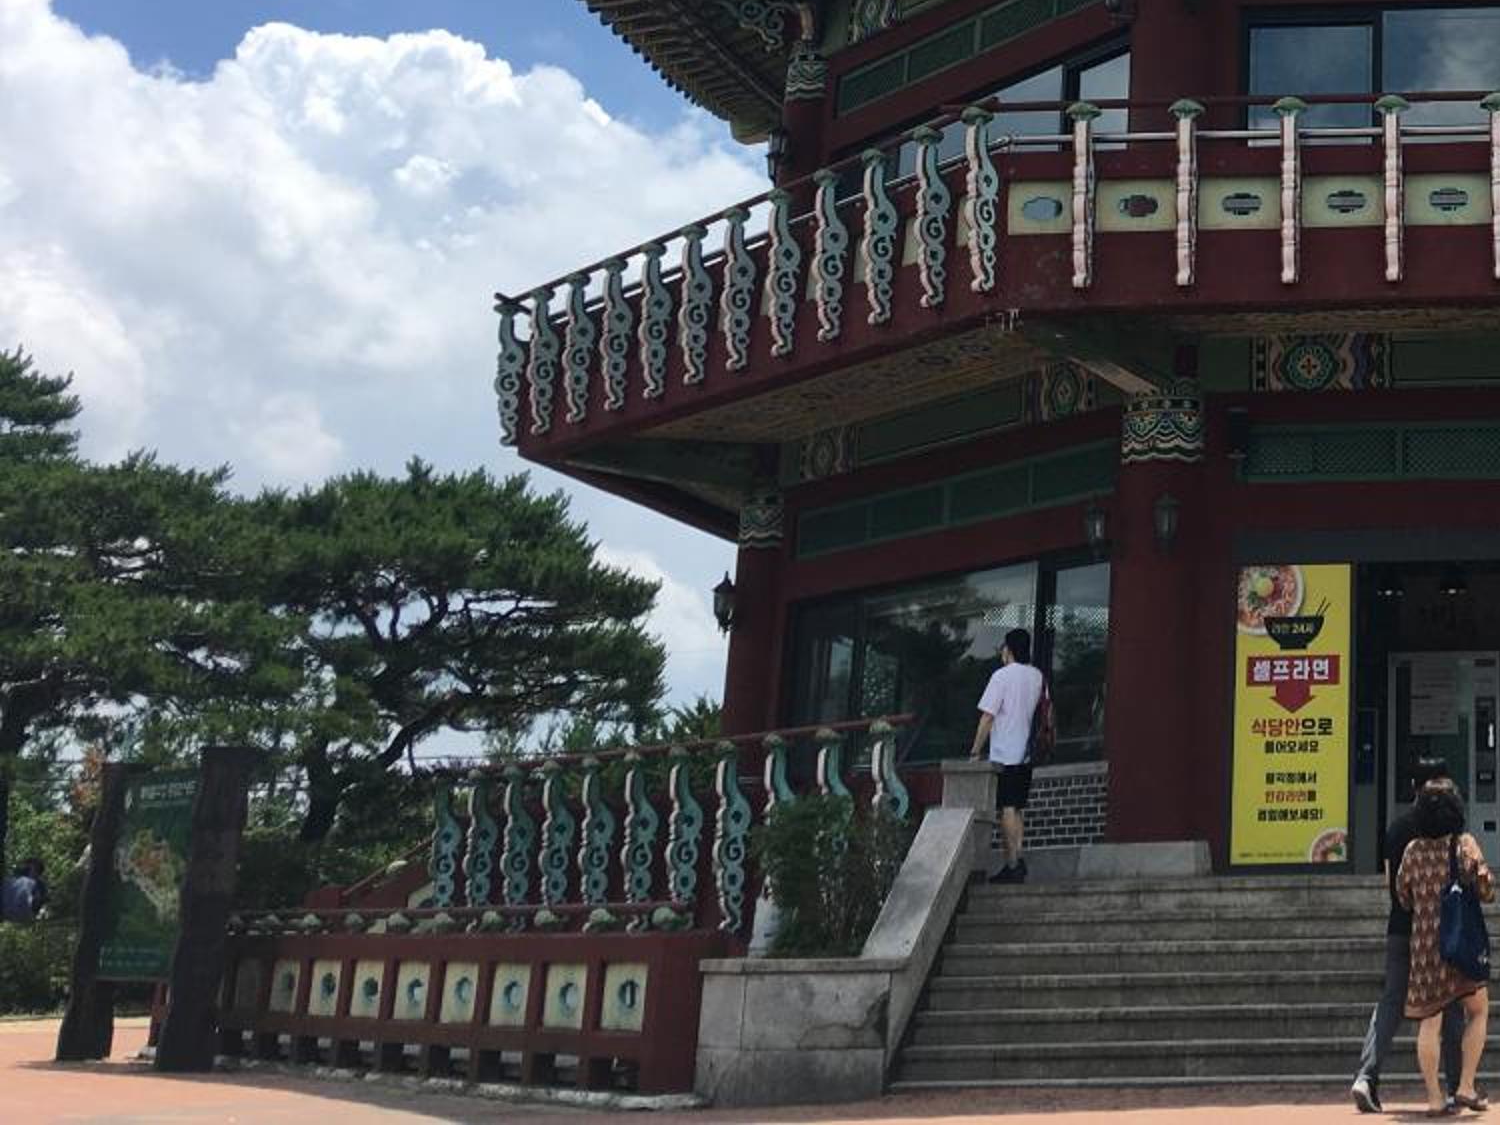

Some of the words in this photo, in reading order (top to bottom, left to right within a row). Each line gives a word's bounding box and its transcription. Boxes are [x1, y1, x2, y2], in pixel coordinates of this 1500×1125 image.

[1253, 658, 1329, 682] 셀프라면
[1251, 717, 1333, 736] 식당안으로
[1265, 740, 1319, 754] 들어오세요
